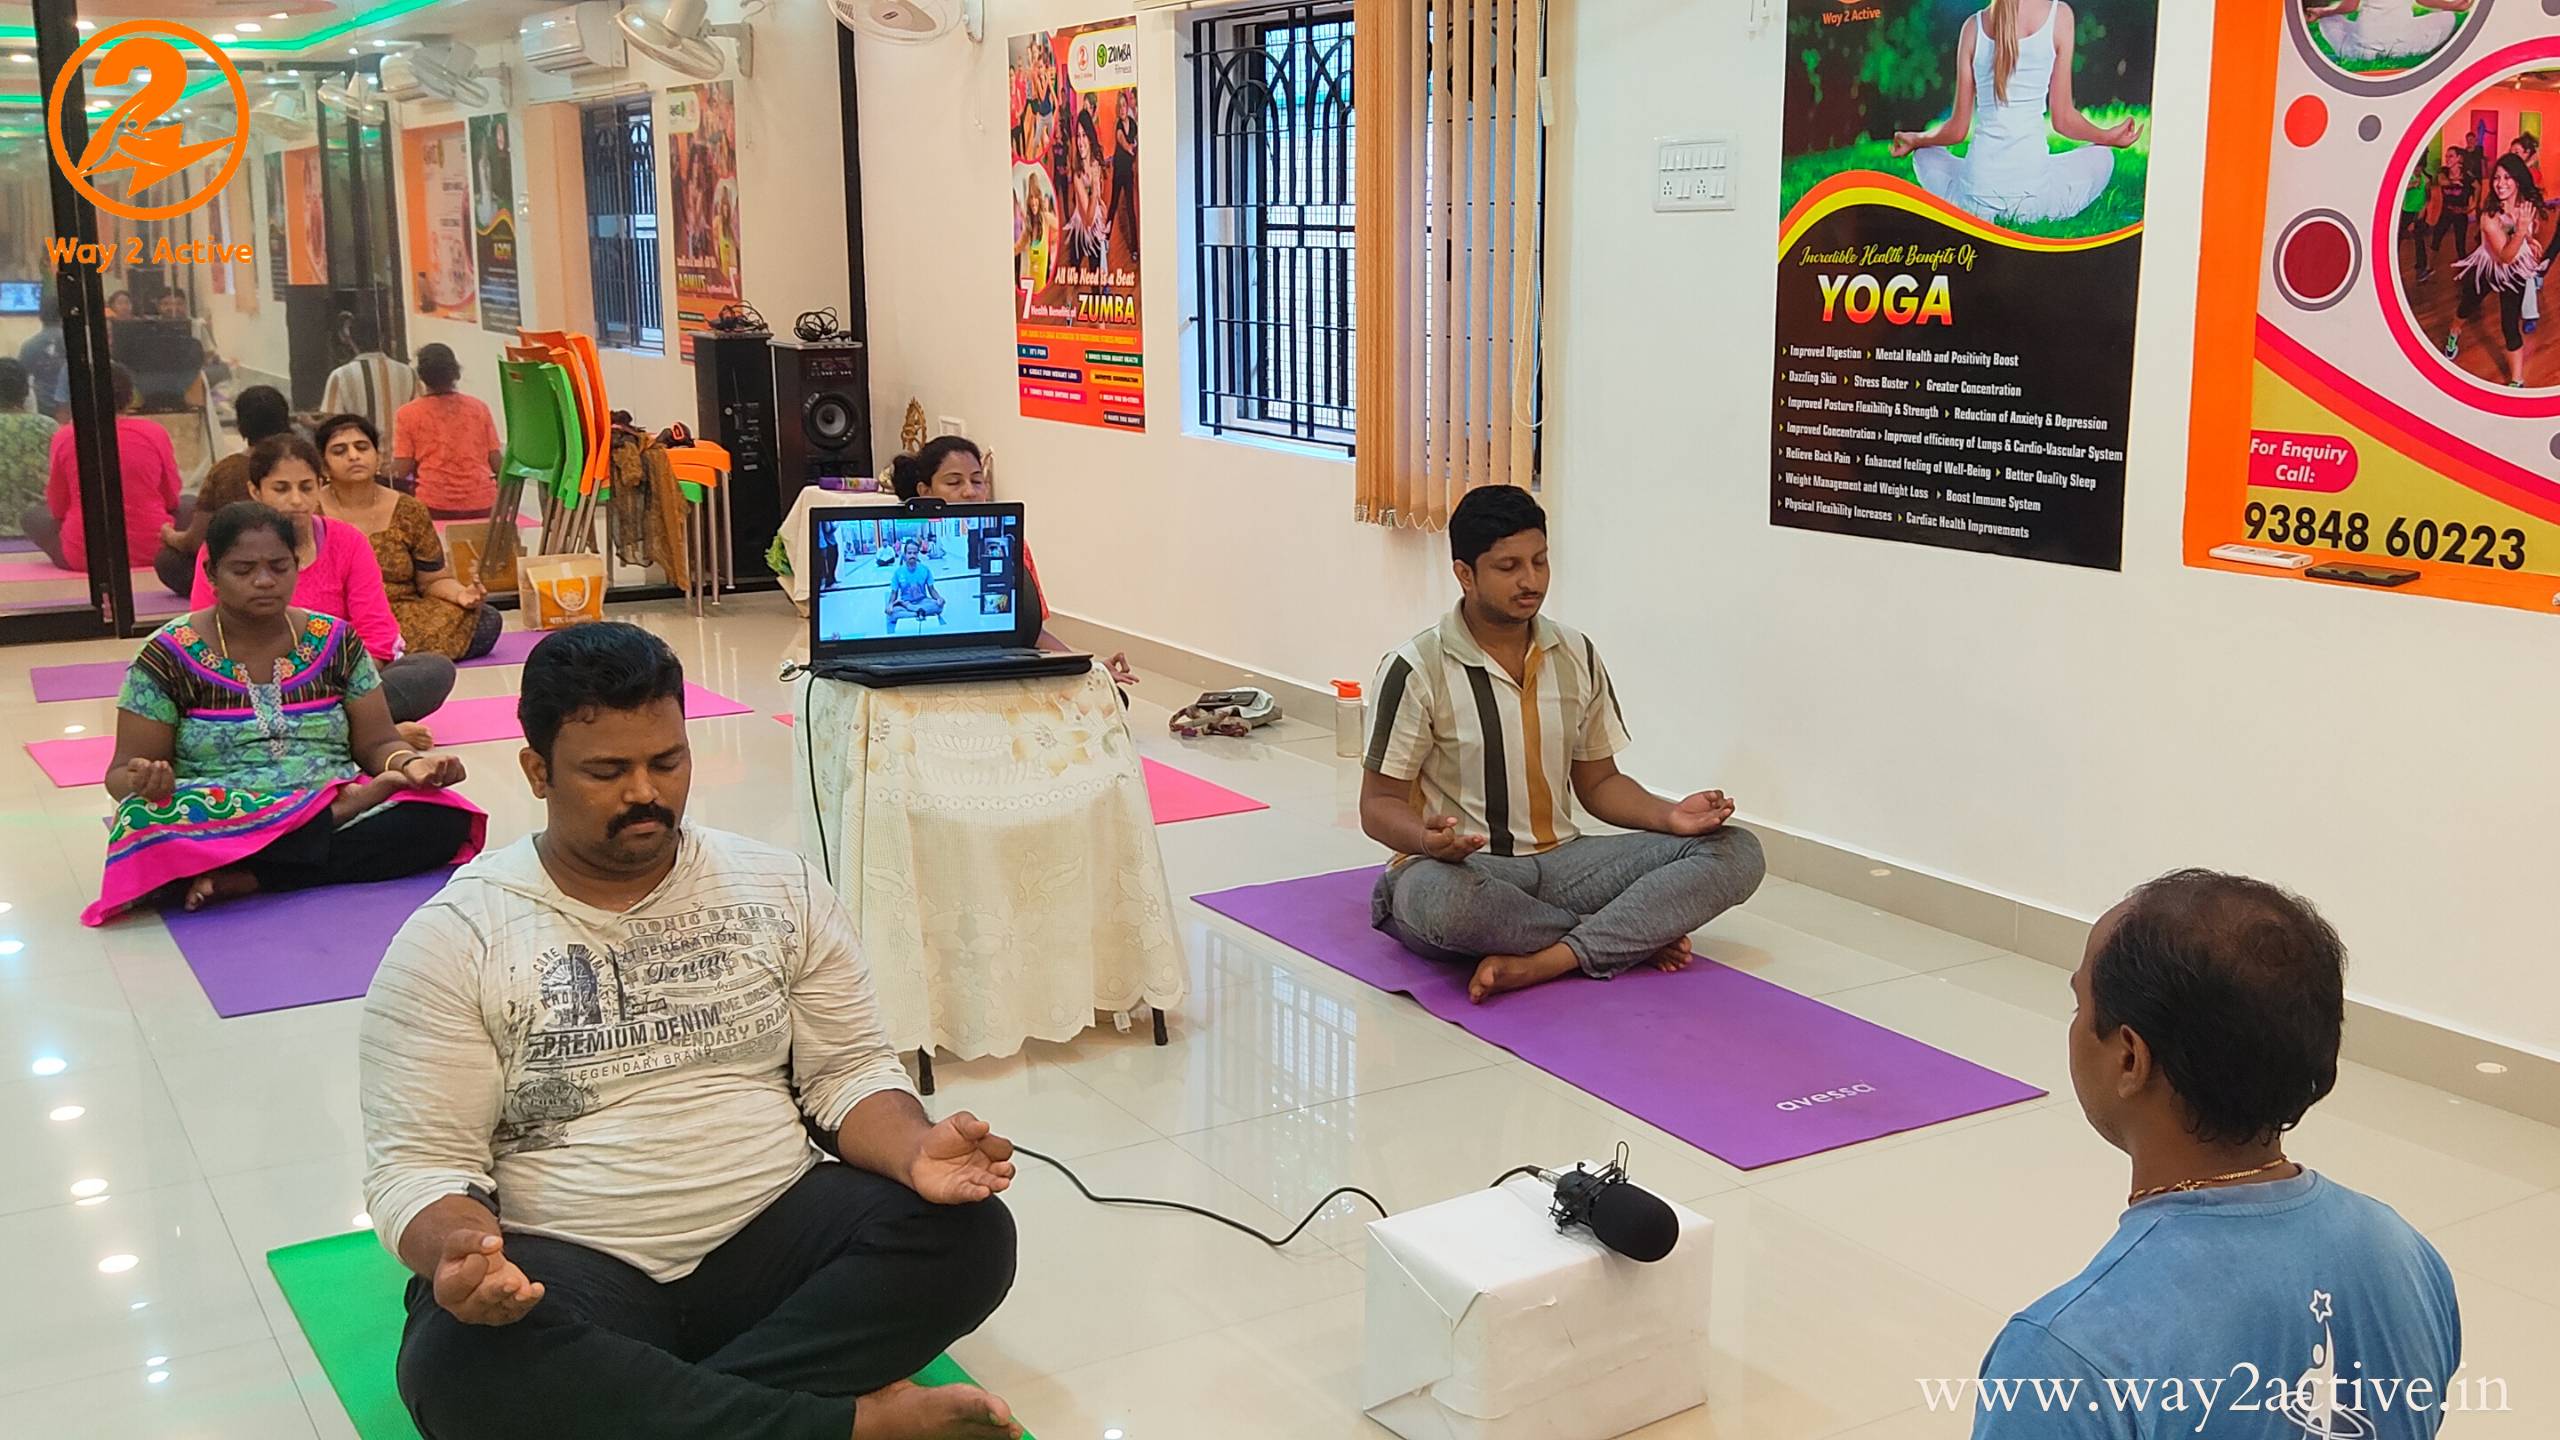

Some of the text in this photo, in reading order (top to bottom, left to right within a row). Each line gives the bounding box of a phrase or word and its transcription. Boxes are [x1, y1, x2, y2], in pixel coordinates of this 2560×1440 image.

[1822, 7, 1881, 27] Way 2 Active
[1108, 43, 1131, 63] ZUMBA
[1799, 244, 1978, 271] Incredible Health Benefits Of
[1055, 266, 1135, 286] All We Need is a Beat
[1020, 279, 1034, 319] 7
[1077, 294, 1136, 323] ZUMBA
[1818, 274, 1952, 325] YOGA
[1790, 345, 2019, 368] Improved Digestion Mental Health and Positivity Boost
[1789, 370, 2022, 397] Dazzling Skin Stress Buster Greater Concentration
[1788, 396, 2108, 430] Improved Posture Flexibility & Strength Reduction of Anxiety & Depression
[1787, 421, 2123, 462] Improved Concentration Improved efficiency of Lungs & Cardio-Vascular System
[2250, 438, 2348, 465] For Enquiry
[1786, 447, 2096, 491] Relieve Back Pain Enhanced feeling of Well-Being Better Quality Sleep
[2275, 464, 2316, 484] Call:
[1785, 472, 2041, 512] Weight Management and Weight Loss Boost Immune System
[1784, 497, 2030, 539] Physical Flexibility Increases Cardiac Health Improvements
[2244, 502, 2526, 571] 93848 60223
[628, 905, 777, 936] ICONIC BRAND
[533, 947, 560, 973] CORE
[642, 932, 738, 957] GENERATION
[650, 951, 734, 985] Denim
[541, 1006, 721, 1058] PREMIUM DENIM
[664, 1001, 790, 1048] GENDARY BRAN
[570, 1056, 660, 1082] LEGENDARY
[664, 1043, 713, 1065] BRAND
[1776, 1083, 1877, 1111] avessa
